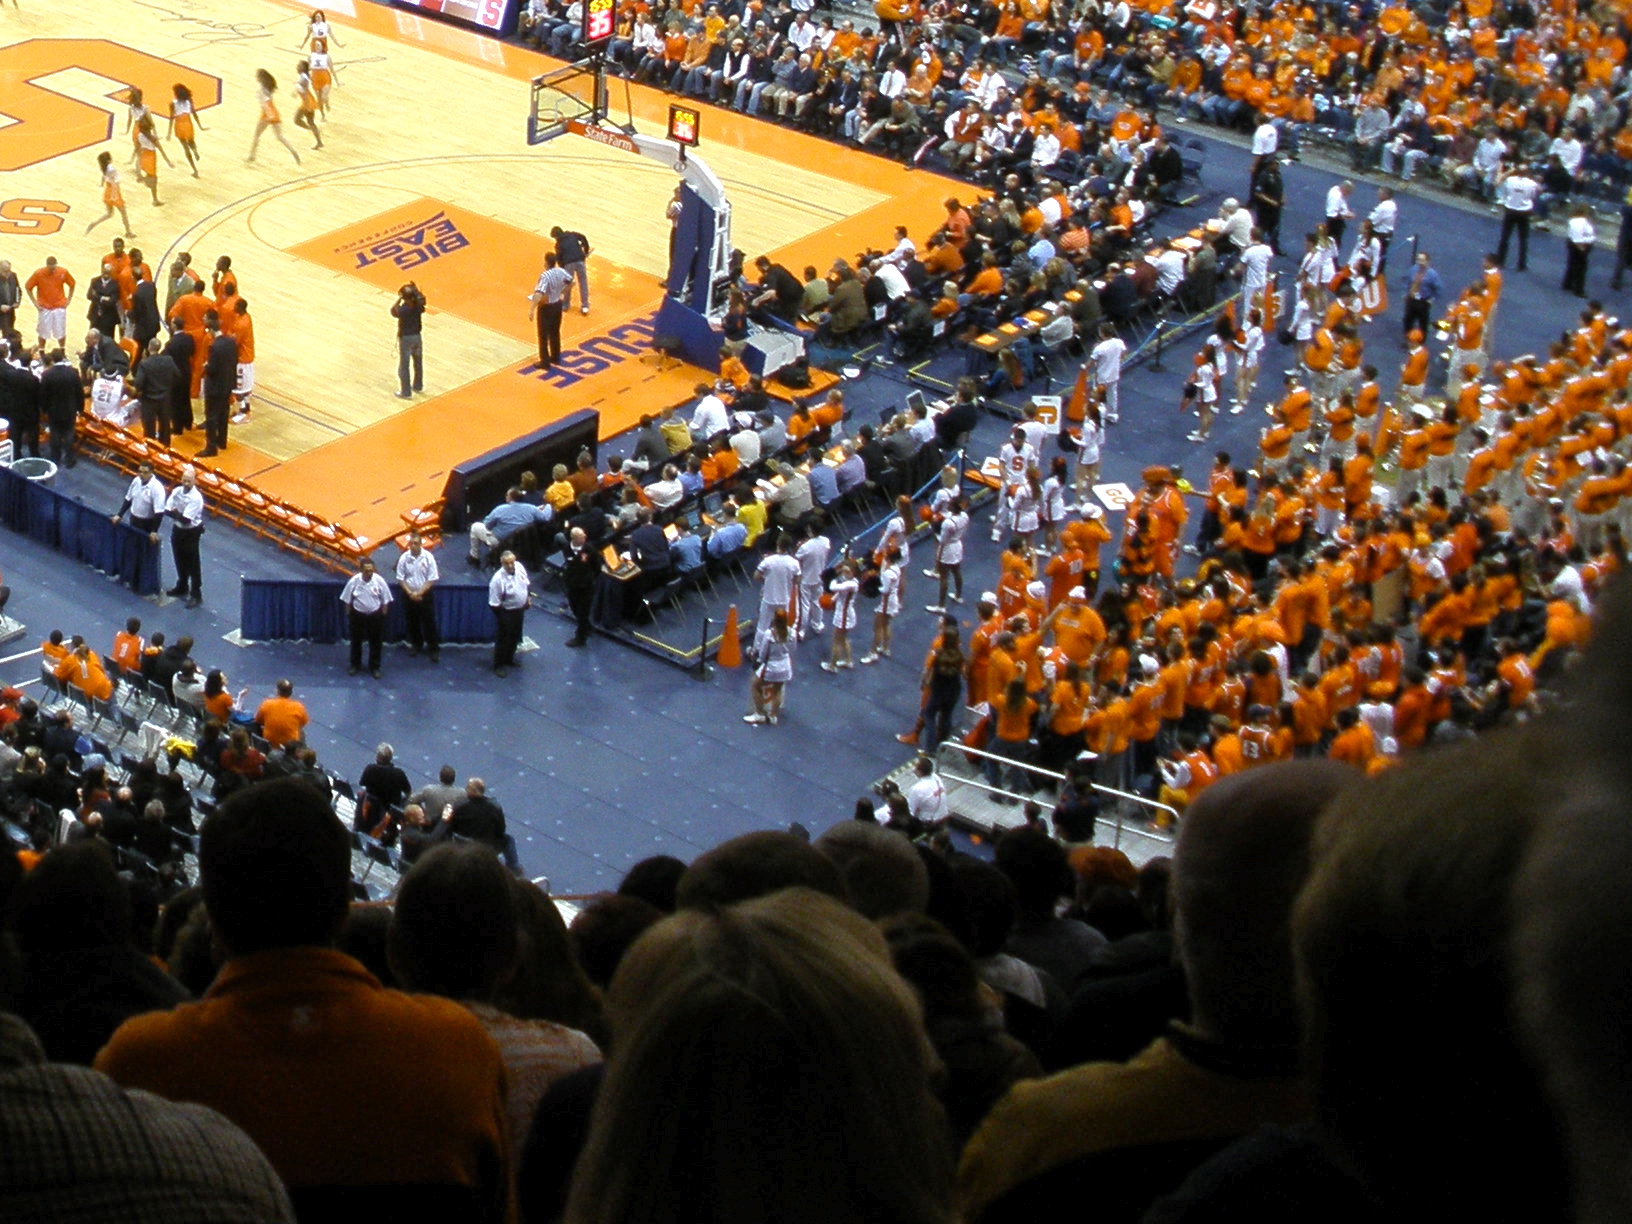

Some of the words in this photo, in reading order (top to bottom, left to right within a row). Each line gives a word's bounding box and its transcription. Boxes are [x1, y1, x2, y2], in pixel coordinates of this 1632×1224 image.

[589, 11, 611, 38] 35
[583, 126, 608, 143] State
[609, 135, 633, 151] Farm
[355, 219, 456, 269] EAST
[393, 232, 470, 270] BIG
[97, 390, 111, 403] 21
[1012, 456, 1024, 471] S
[1105, 488, 1128, 505] GO
